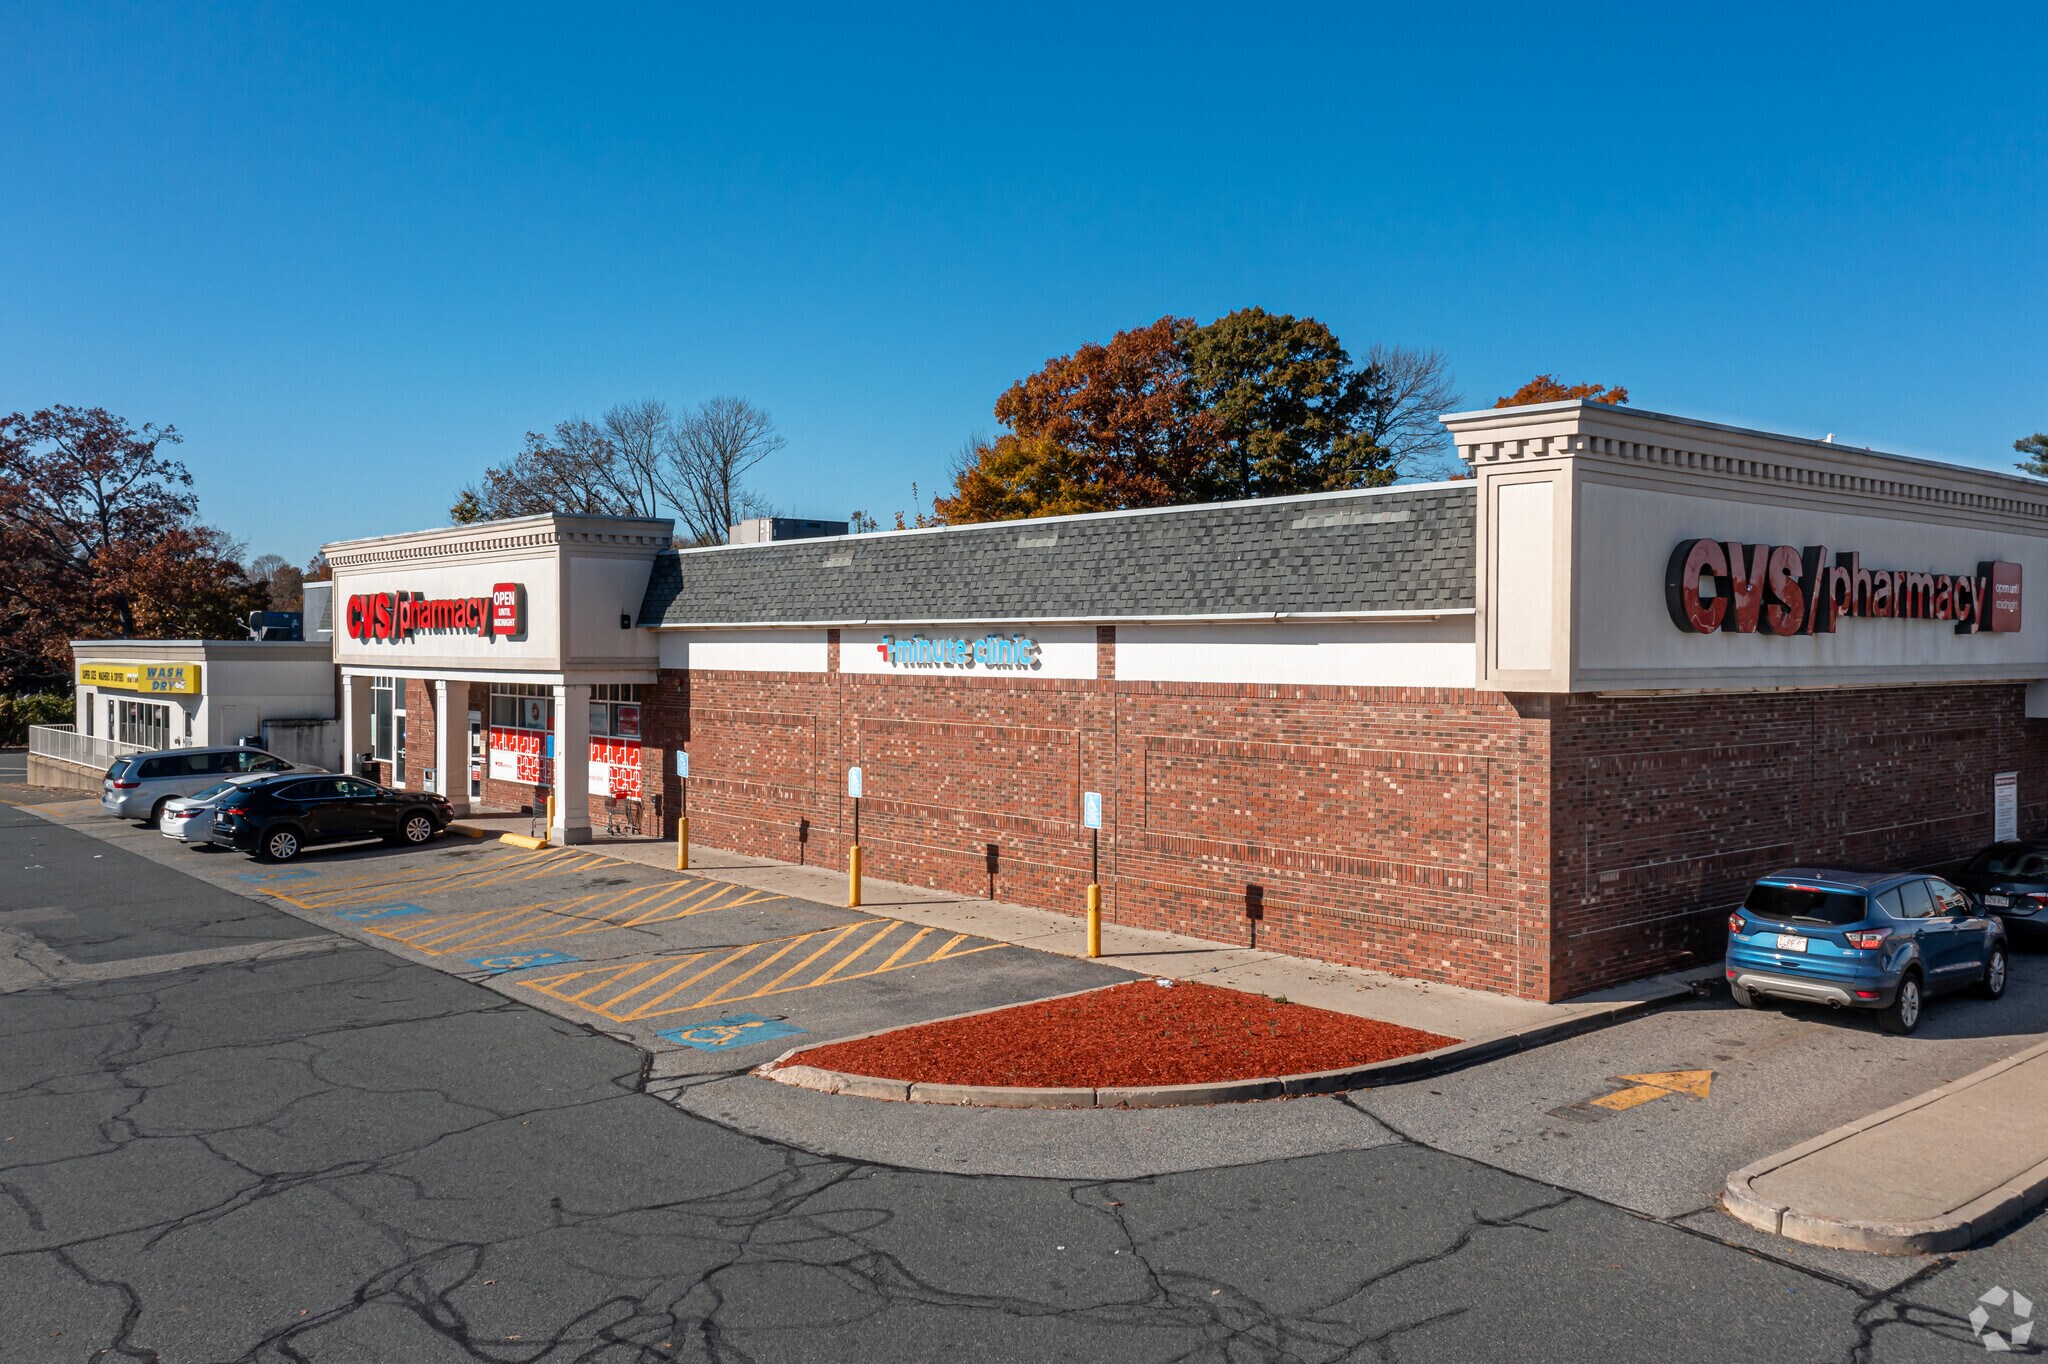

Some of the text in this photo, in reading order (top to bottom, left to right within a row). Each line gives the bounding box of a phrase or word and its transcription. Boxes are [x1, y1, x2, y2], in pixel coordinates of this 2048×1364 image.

[1682, 538, 1987, 636] CVS/pharmacy
[493, 591, 515, 606] OPEN
[346, 590, 489, 639] CVS/pharmacy
[498, 607, 512, 616] UNTIL
[493, 618, 515, 627] MIDNIGHT
[894, 633, 1032, 665] minute clinic
[146, 667, 184, 677] WASH
[151, 681, 175, 691] DRY
